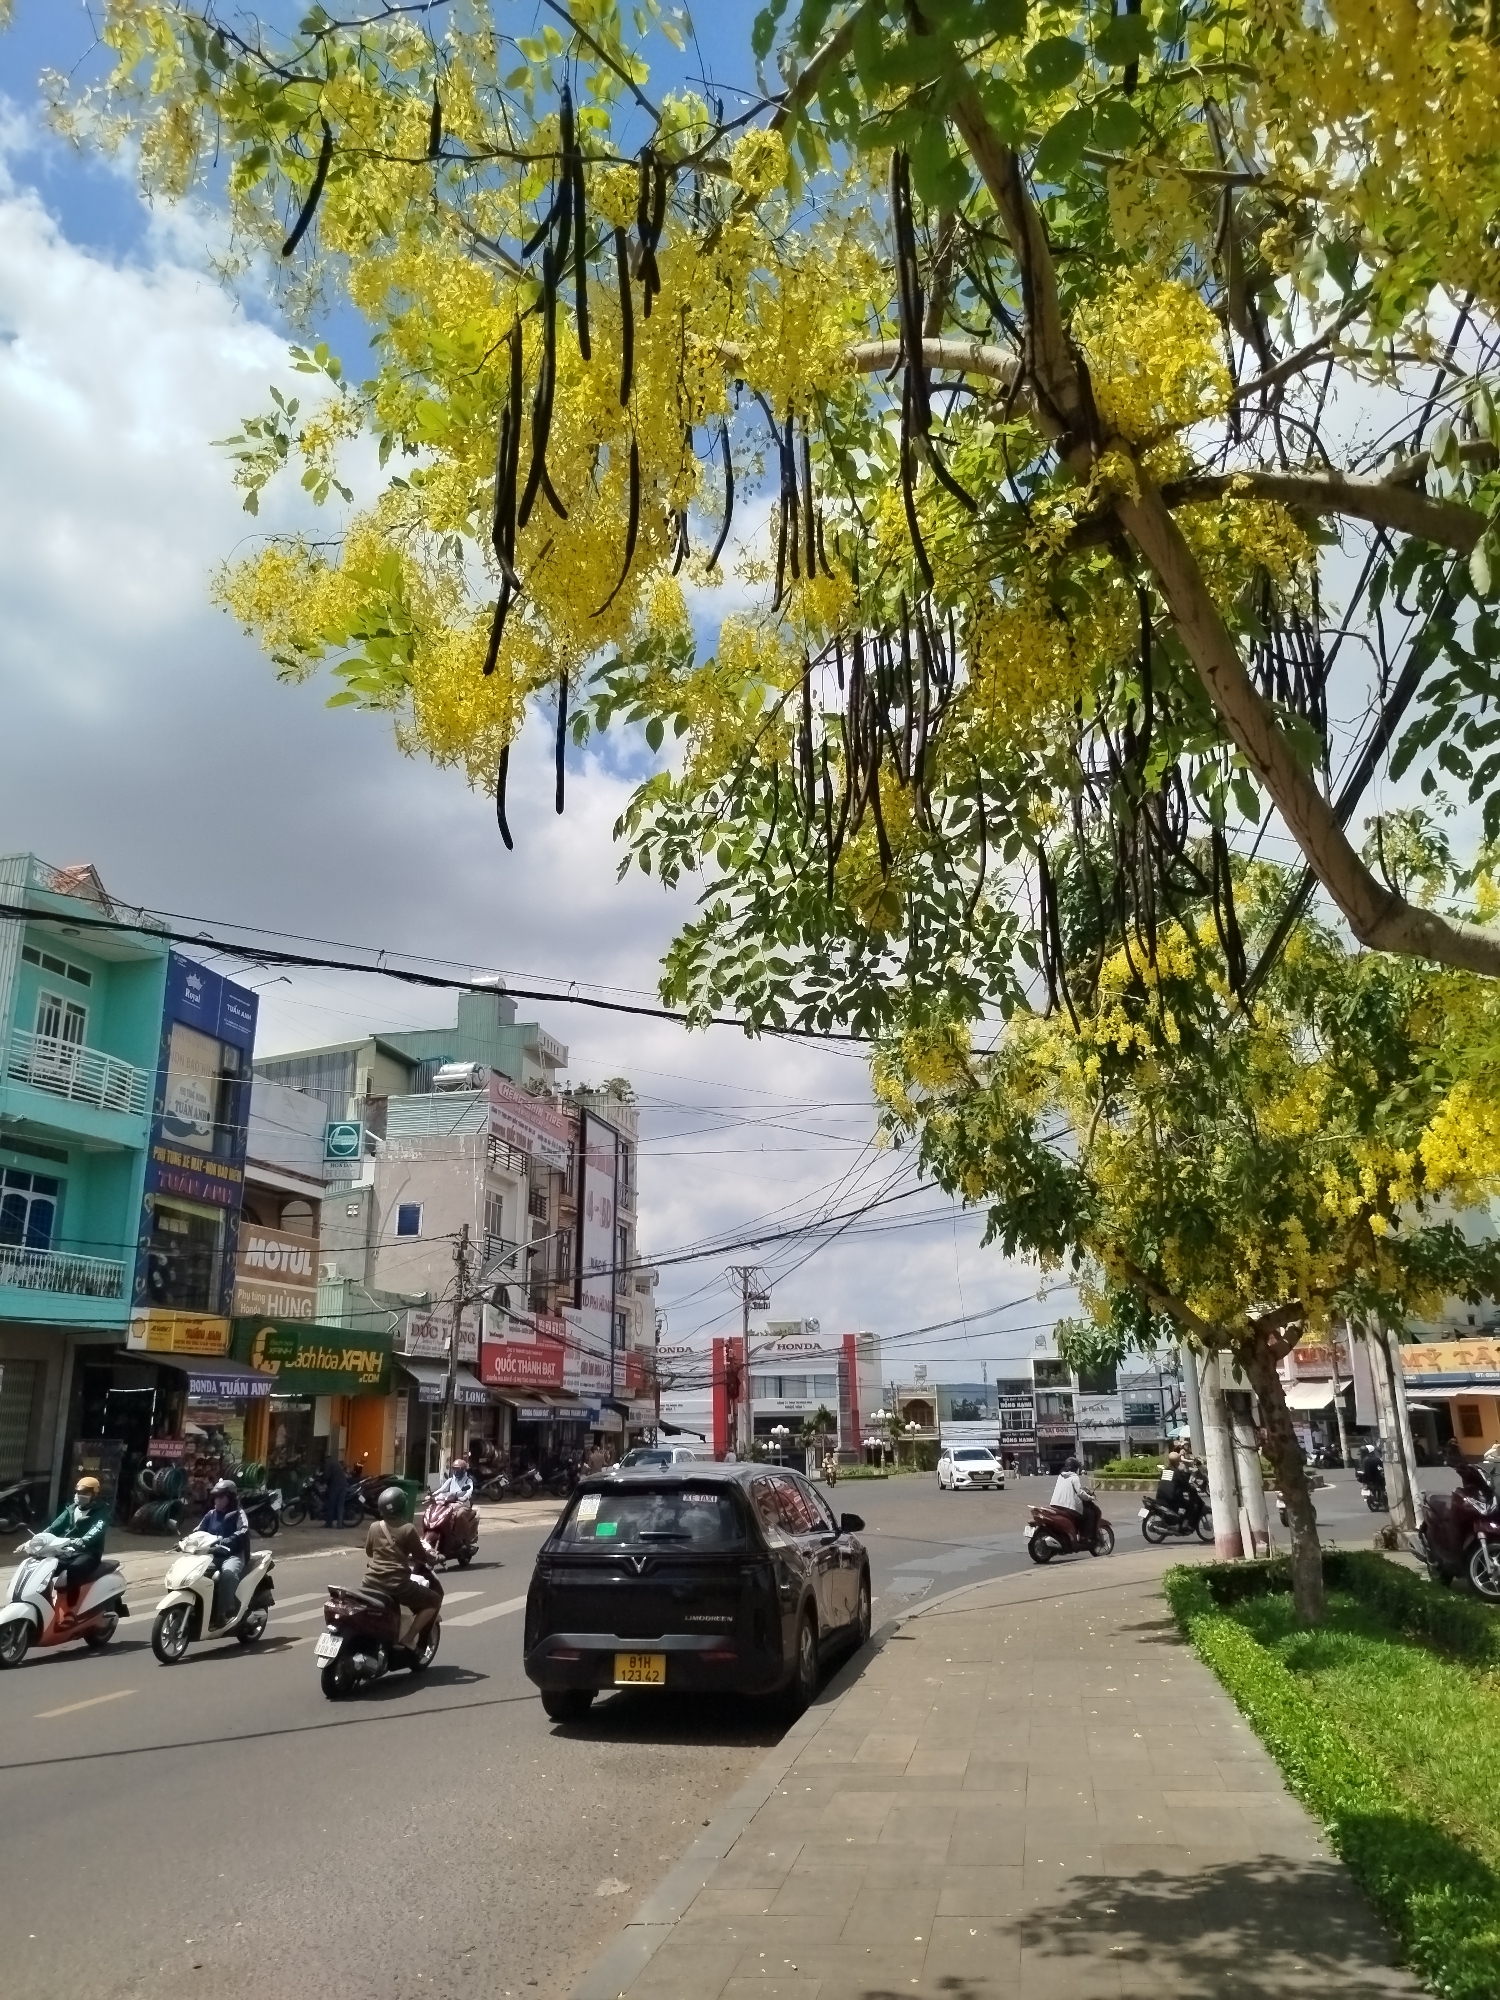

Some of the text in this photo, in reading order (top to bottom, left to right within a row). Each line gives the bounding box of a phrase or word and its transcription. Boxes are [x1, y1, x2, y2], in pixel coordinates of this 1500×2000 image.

[185, 987, 201, 1003] Royal
[226, 1003, 251, 1020] TUẤN ANH
[175, 1099, 208, 1122] TUẤN ANH
[545, 1111, 564, 1128] TIRE
[158, 1171, 233, 1204] TUẤN ANH
[244, 1237, 313, 1276] MOTUL
[237, 1288, 266, 1305] Phụ tùng
[266, 1290, 312, 1319] HÙNG
[240, 1304, 261, 1314] Honda
[267, 1347, 293, 1355] XANH
[776, 1342, 822, 1351] HONDA
[316, 1346, 339, 1370] hóa
[339, 1349, 384, 1373] XANH
[1400, 1345, 1500, 1368] MỸ TÂ
[494, 1353, 517, 1375] QUỐC
[517, 1356, 542, 1375] THÀNH
[542, 1362, 556, 1379] ĐẠT
[358, 1373, 380, 1383] .COM
[190, 1378, 273, 1396] HONDA TUẤN ANH
[465, 1391, 486, 1403] LONG
[698, 1494, 716, 1502] TAXI
[629, 1656, 651, 1668] 81H
[621, 1670, 660, 1682] 123.42
